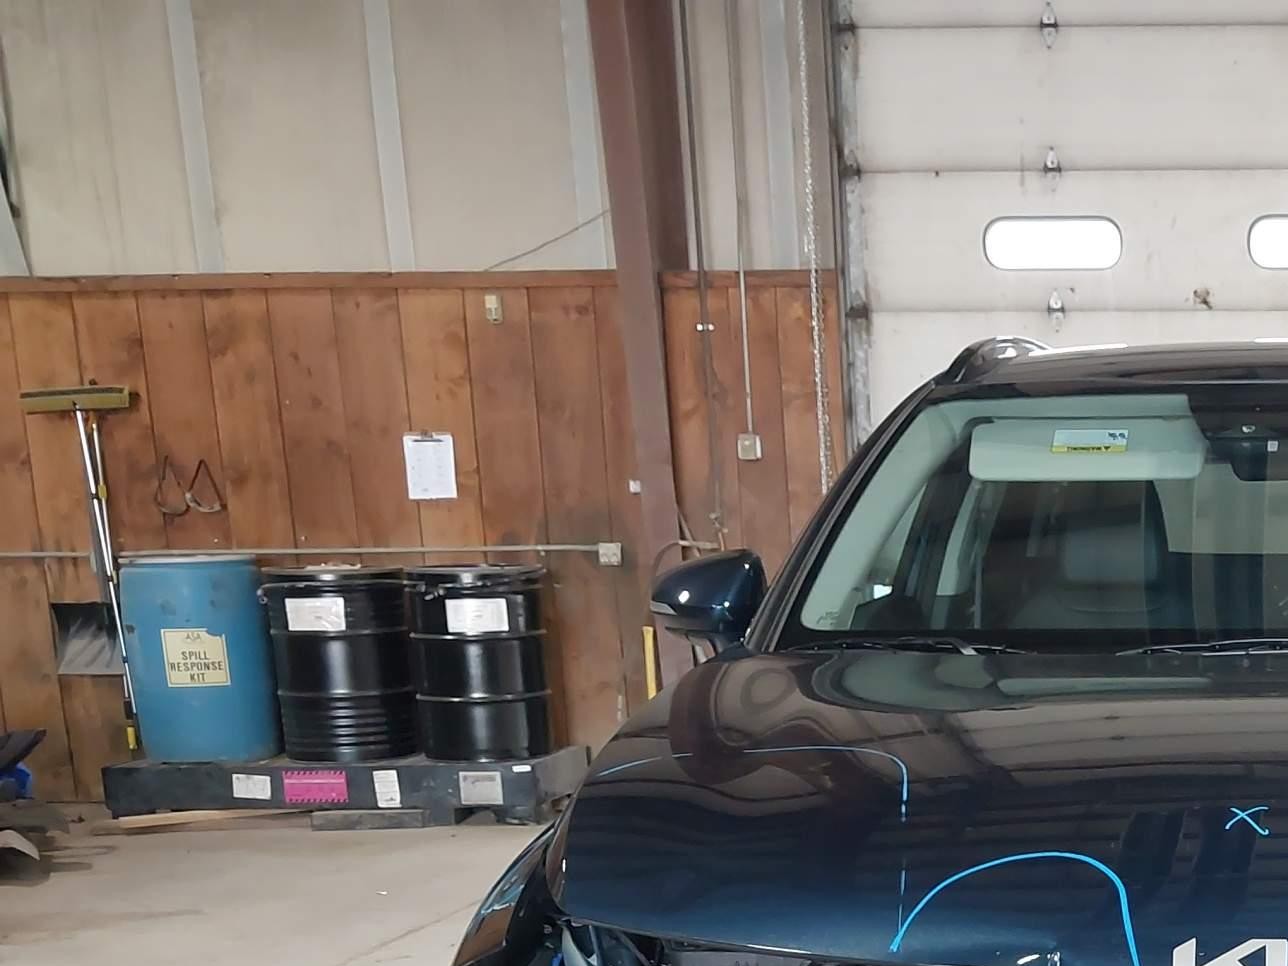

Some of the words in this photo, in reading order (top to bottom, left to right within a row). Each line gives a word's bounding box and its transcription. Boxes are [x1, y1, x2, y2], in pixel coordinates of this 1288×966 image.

[181, 650, 208, 661] SPILL
[169, 661, 224, 672] RESPONSE
[190, 672, 206, 683] KIT
